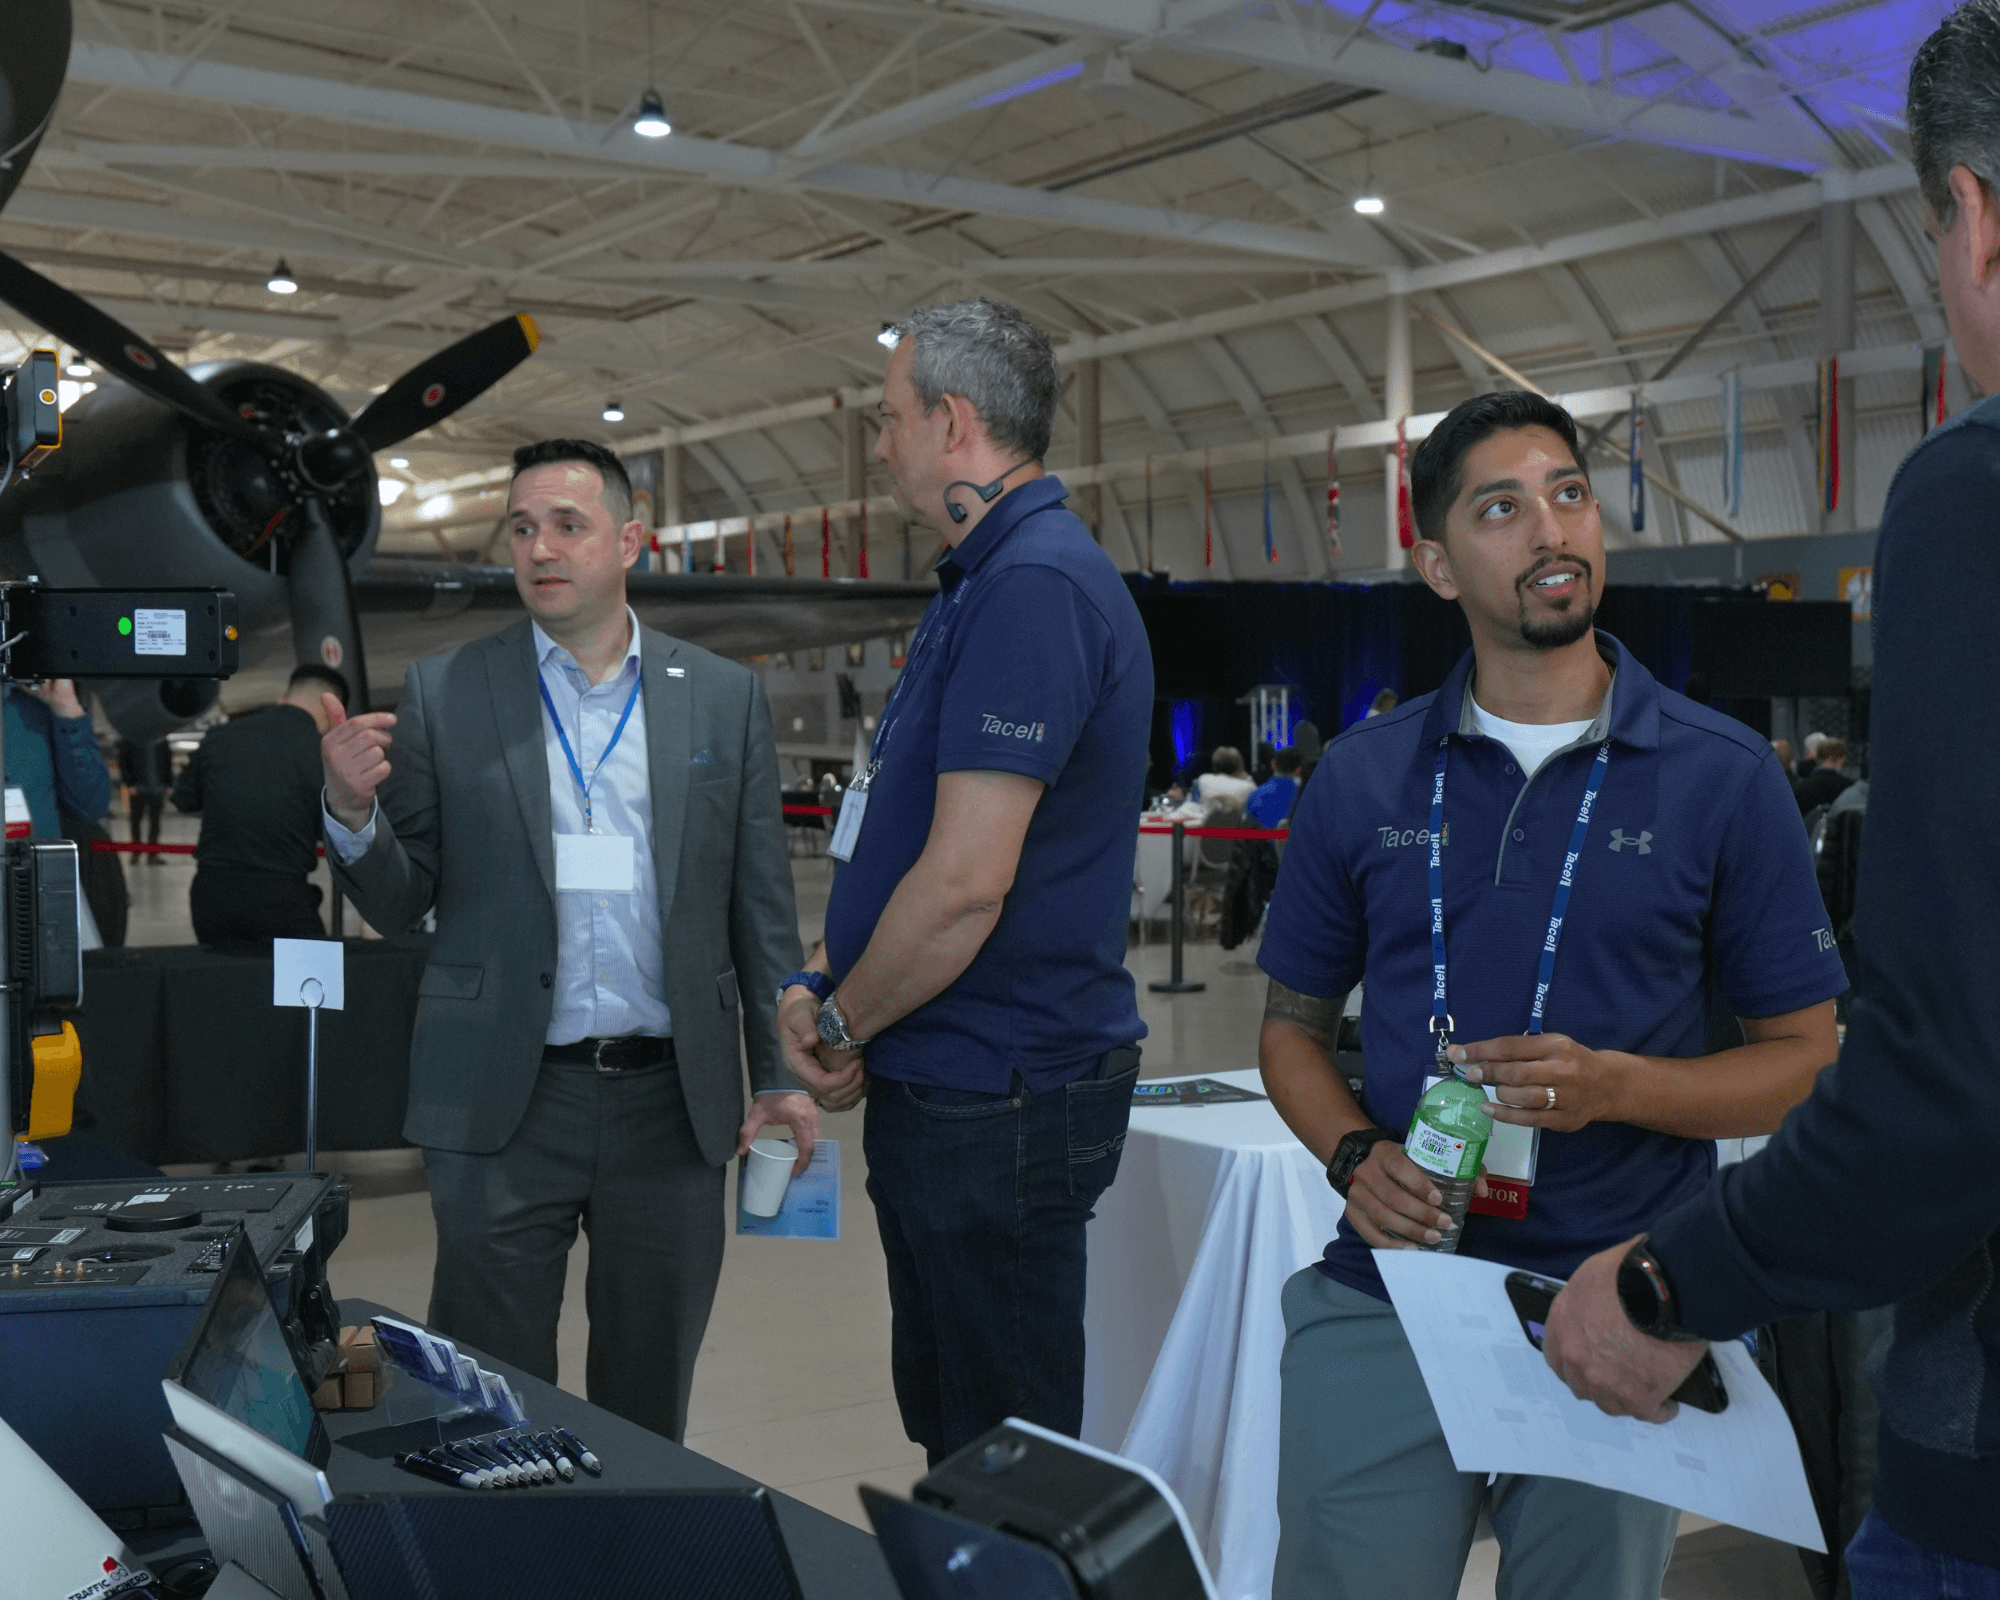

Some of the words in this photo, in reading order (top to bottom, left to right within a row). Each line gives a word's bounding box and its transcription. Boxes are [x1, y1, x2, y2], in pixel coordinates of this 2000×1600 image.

[981, 713, 1037, 740] Tacel
[1432, 774, 1445, 805] Tacel
[1578, 789, 1597, 821] Tacel
[1378, 826, 1430, 848] Tace
[1430, 836, 1441, 868] Tacel
[1561, 851, 1579, 884] Tacel
[1431, 901, 1442, 934] Tacel
[1545, 916, 1562, 950] Tacel
[1433, 968, 1446, 1000] Tacel
[1533, 982, 1549, 1016] Tacel
[1488, 1188, 1518, 1204] TOR
